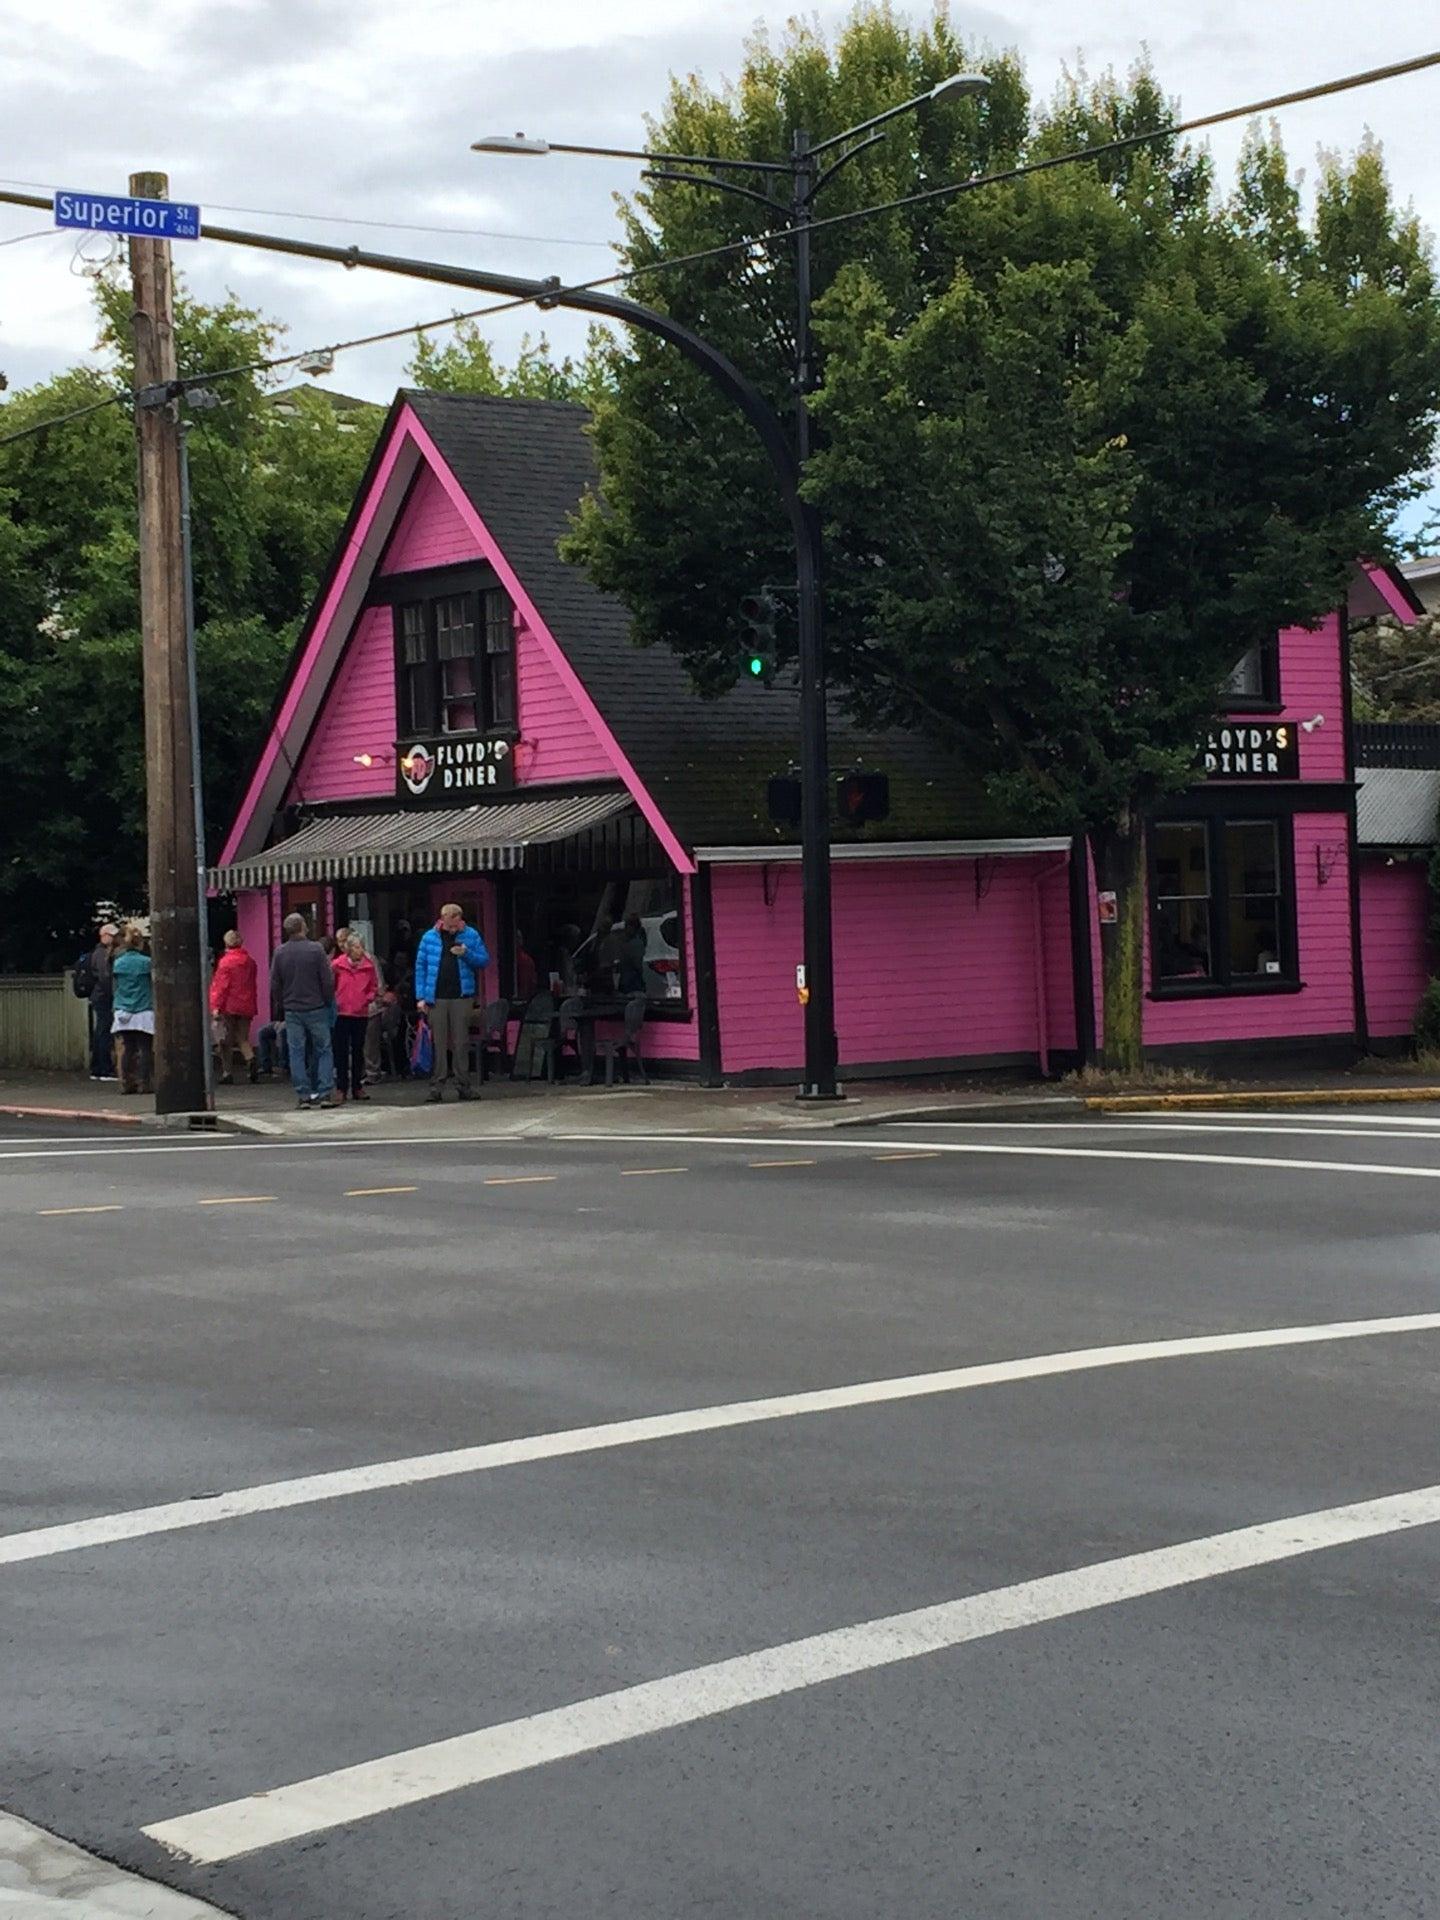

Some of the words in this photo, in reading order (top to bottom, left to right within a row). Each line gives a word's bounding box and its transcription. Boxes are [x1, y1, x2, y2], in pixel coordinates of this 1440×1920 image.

[60, 196, 168, 228] Superior
[1195, 728, 1288, 749] LOYD'S
[1204, 753, 1278, 773] DINER
[444, 765, 496, 788] DINER
